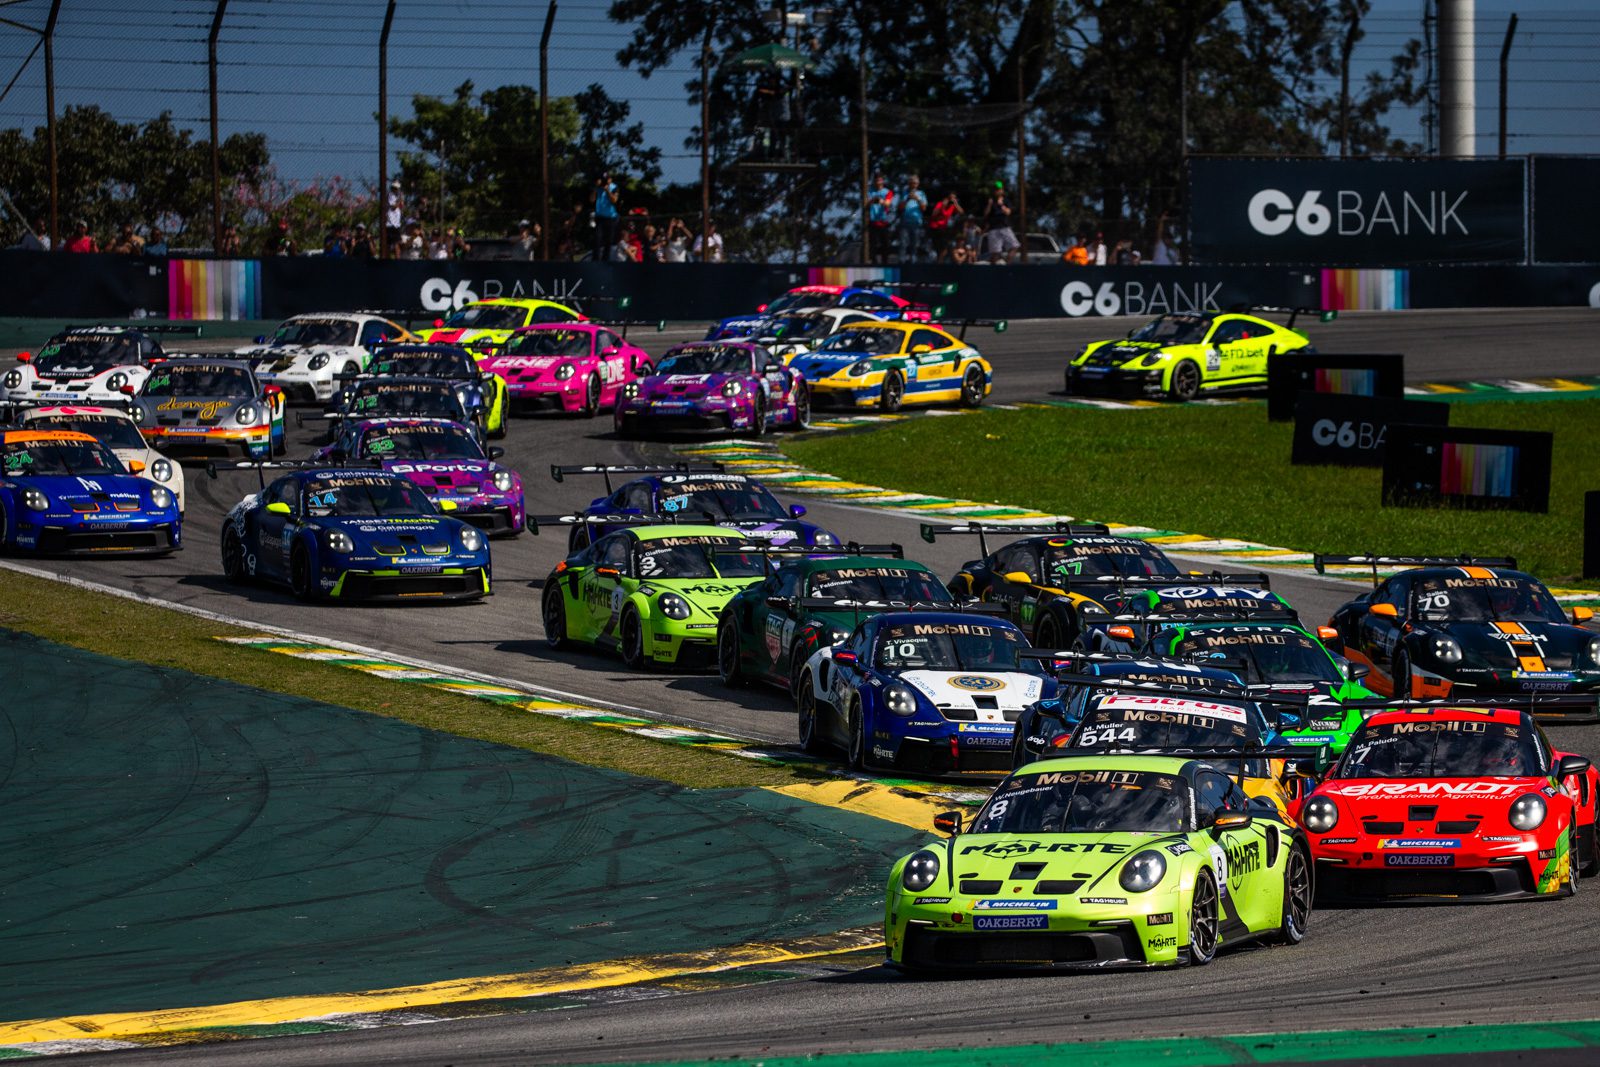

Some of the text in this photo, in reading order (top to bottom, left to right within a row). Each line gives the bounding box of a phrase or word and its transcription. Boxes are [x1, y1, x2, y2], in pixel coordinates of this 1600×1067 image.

[1248, 188, 1469, 236] C6 BANK
[420, 277, 479, 312] C6
[1060, 280, 1223, 317] C6 BANK
[387, 427, 427, 435] Mobil
[1312, 419, 1356, 448] C6
[24, 439, 68, 448] Mobil
[415, 464, 483, 472] Porto
[329, 478, 374, 487] Mobil
[682, 482, 726, 492] Mobil
[309, 492, 337, 507] 14
[663, 496, 689, 512] 87
[90, 522, 129, 530] OAKBERRY
[663, 536, 711, 546] Mobil
[1073, 546, 1121, 556] Mobil
[640, 556, 657, 570] 3
[1055, 561, 1082, 575] 17
[401, 566, 441, 574] OAKBERRY
[838, 569, 888, 579] Mobil
[1445, 579, 1498, 588] Mobil
[613, 593, 619, 610] 3
[1184, 598, 1238, 609] Mobil
[1418, 594, 1451, 611] 70
[914, 624, 970, 635] Mobil
[1190, 626, 1296, 637] EVORA
[1207, 634, 1264, 647] Mobil
[884, 643, 916, 661] 10
[1127, 674, 1188, 685] Mobil
[1522, 682, 1569, 691] OAKBERRY
[1107, 696, 1242, 715] Patrus
[1123, 709, 1190, 725] Mobil
[1096, 722, 1124, 731] Muller
[1392, 721, 1460, 735] Mobil
[966, 737, 1012, 746] OAKBERR
[1079, 727, 1137, 747] 544
[1356, 737, 1399, 751] M. Paludo
[1355, 746, 1372, 765] 7
[1036, 771, 1111, 786] Mobil
[1327, 781, 1536, 797] BRANDT
[1356, 792, 1517, 801] Professional Agriculture
[988, 799, 1010, 820] 8
[1223, 841, 1261, 879] MAHRTE
[1388, 855, 1453, 865] OAKBERRY
[1216, 856, 1223, 881] 8
[991, 900, 1051, 909] MICHELIN
[977, 917, 1045, 930] OAKBERRY
